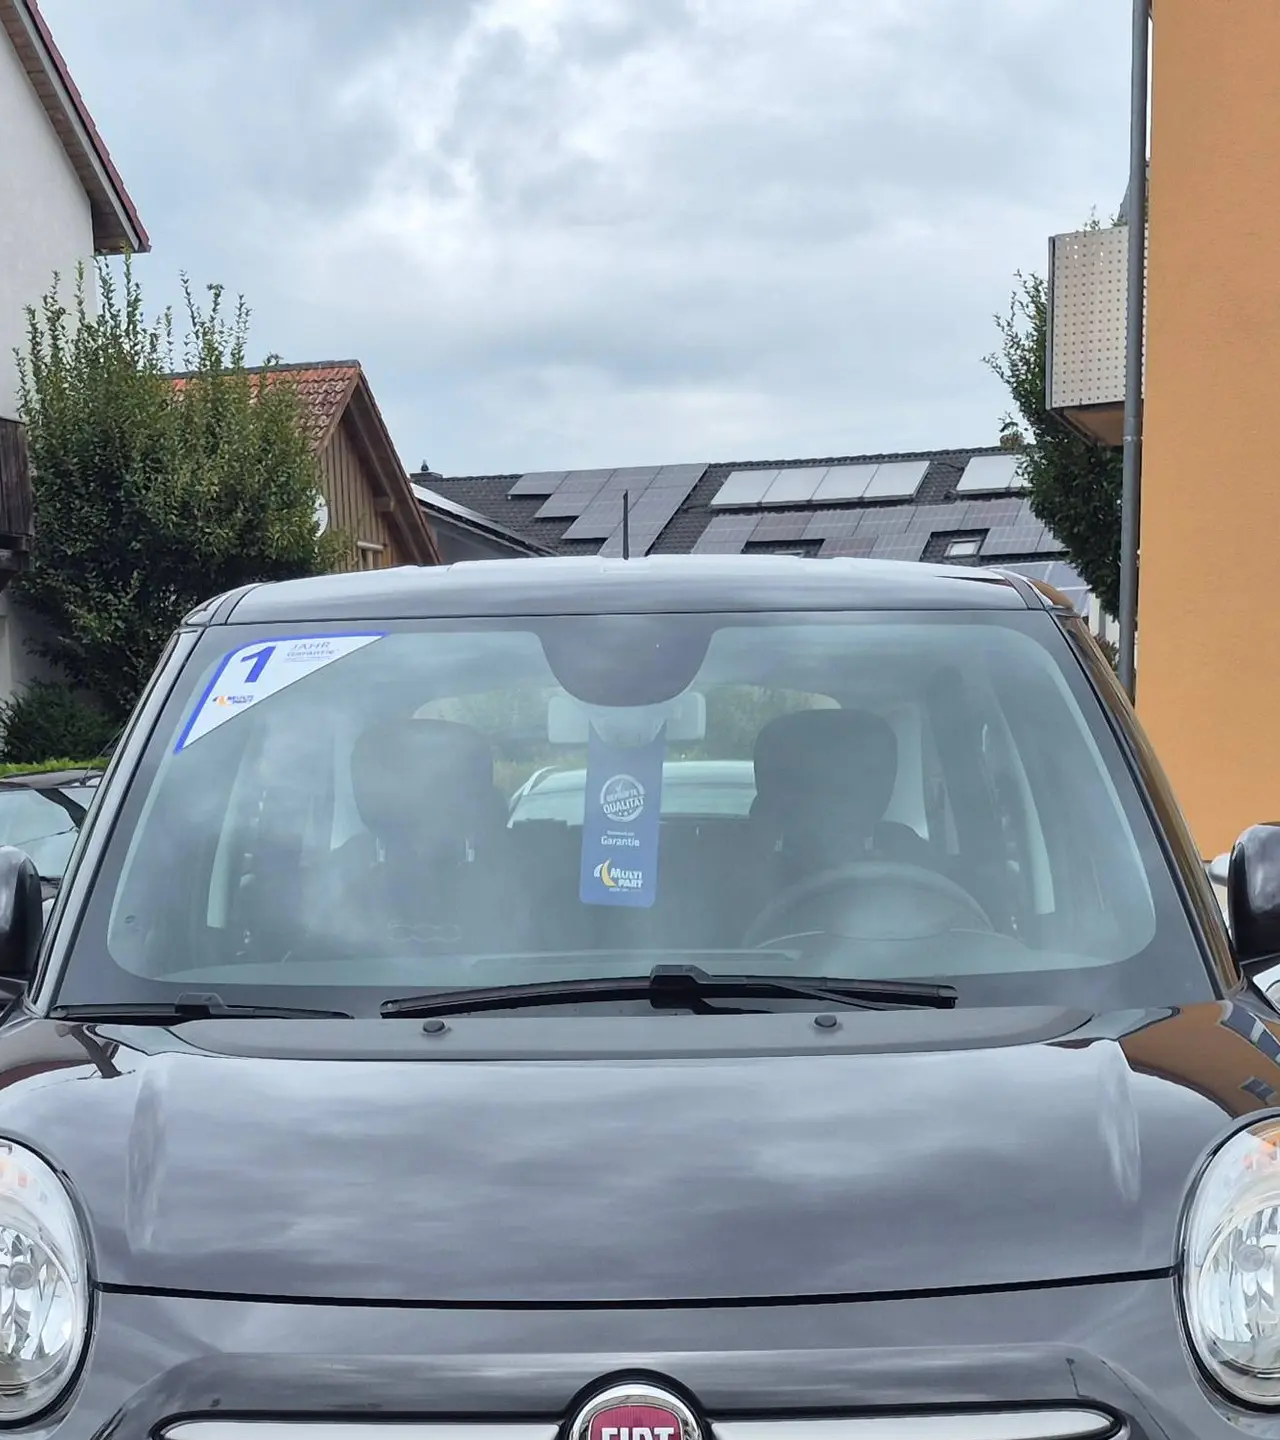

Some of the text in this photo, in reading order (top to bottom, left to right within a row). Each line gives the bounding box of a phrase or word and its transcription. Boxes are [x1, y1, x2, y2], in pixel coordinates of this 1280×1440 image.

[240, 645, 277, 684] 1
[600, 836, 640, 847] Garantie
[610, 867, 642, 879] MULTI
[618, 878, 643, 888] PART
